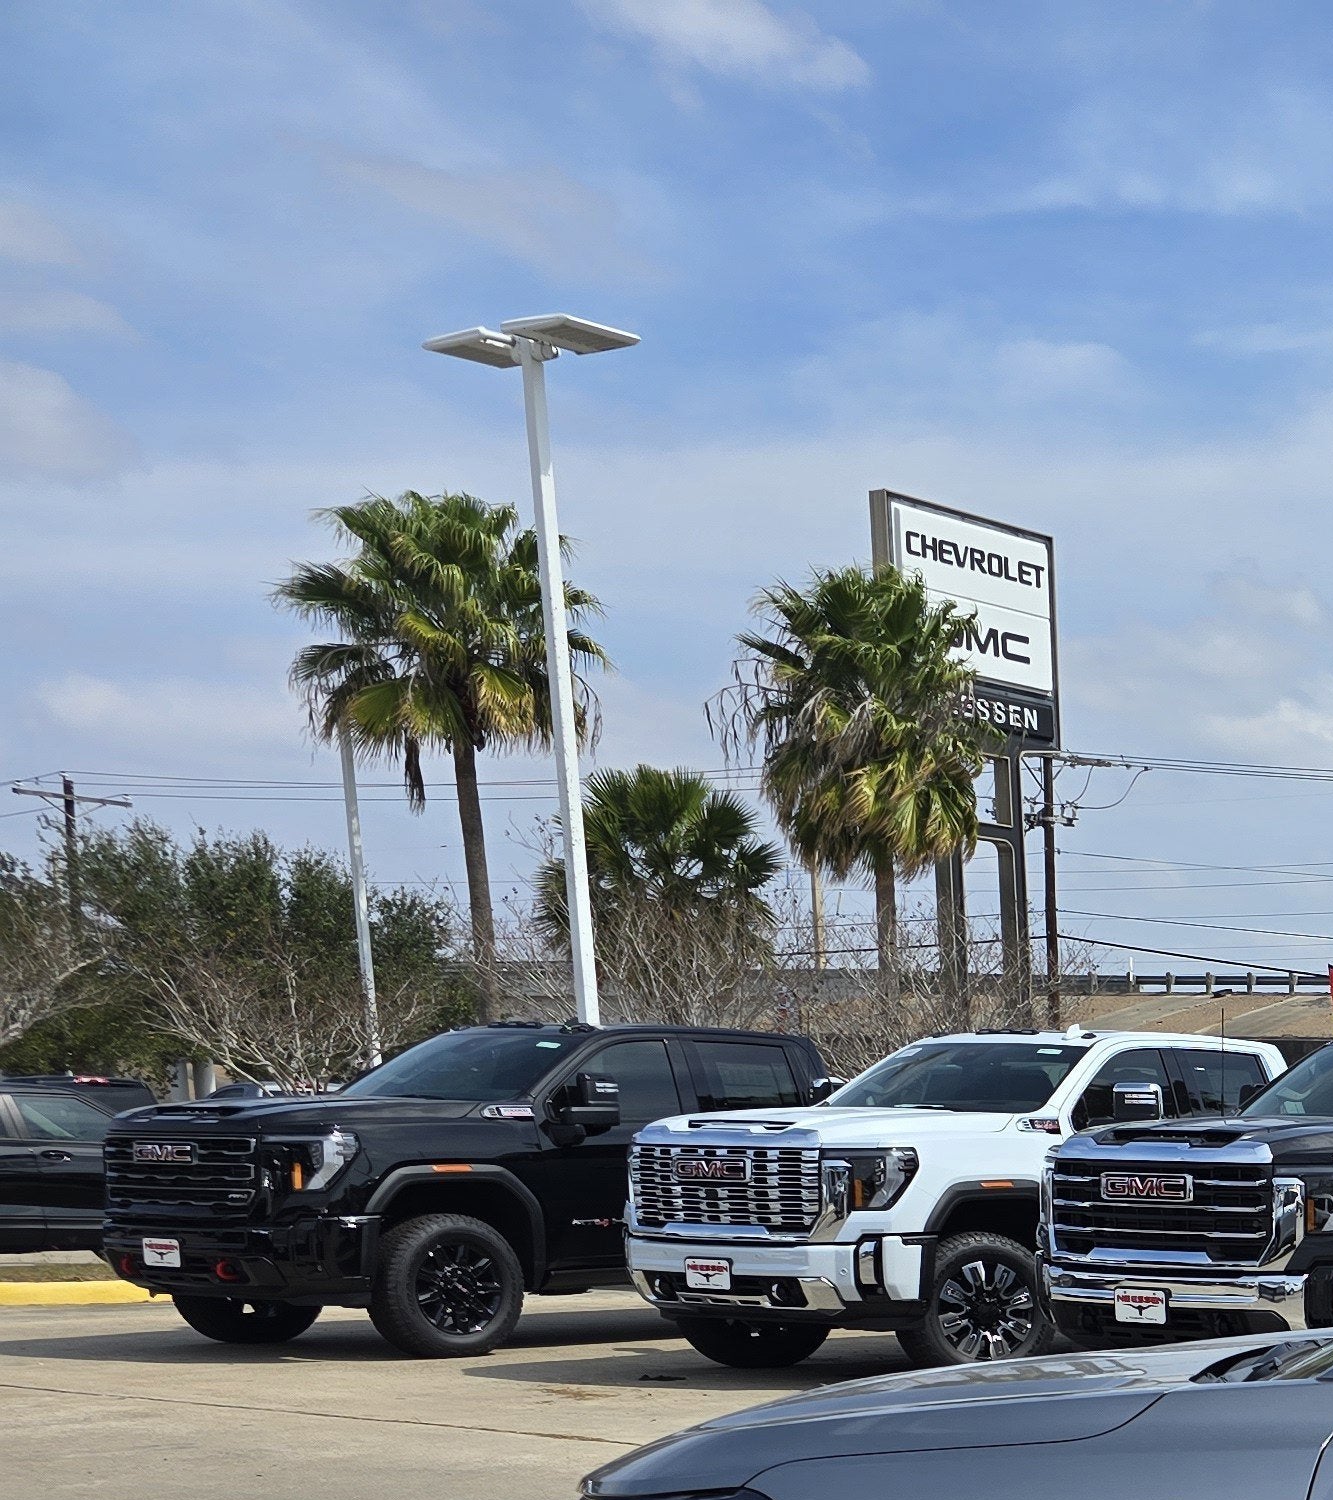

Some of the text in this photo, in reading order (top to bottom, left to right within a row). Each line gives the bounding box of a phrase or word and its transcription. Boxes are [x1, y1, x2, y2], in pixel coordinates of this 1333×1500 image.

[904, 530, 1044, 588] CHEVROLET
[134, 1145, 191, 1161] GMC
[675, 1160, 744, 1178] GMC
[1104, 1177, 1184, 1197] GMC
